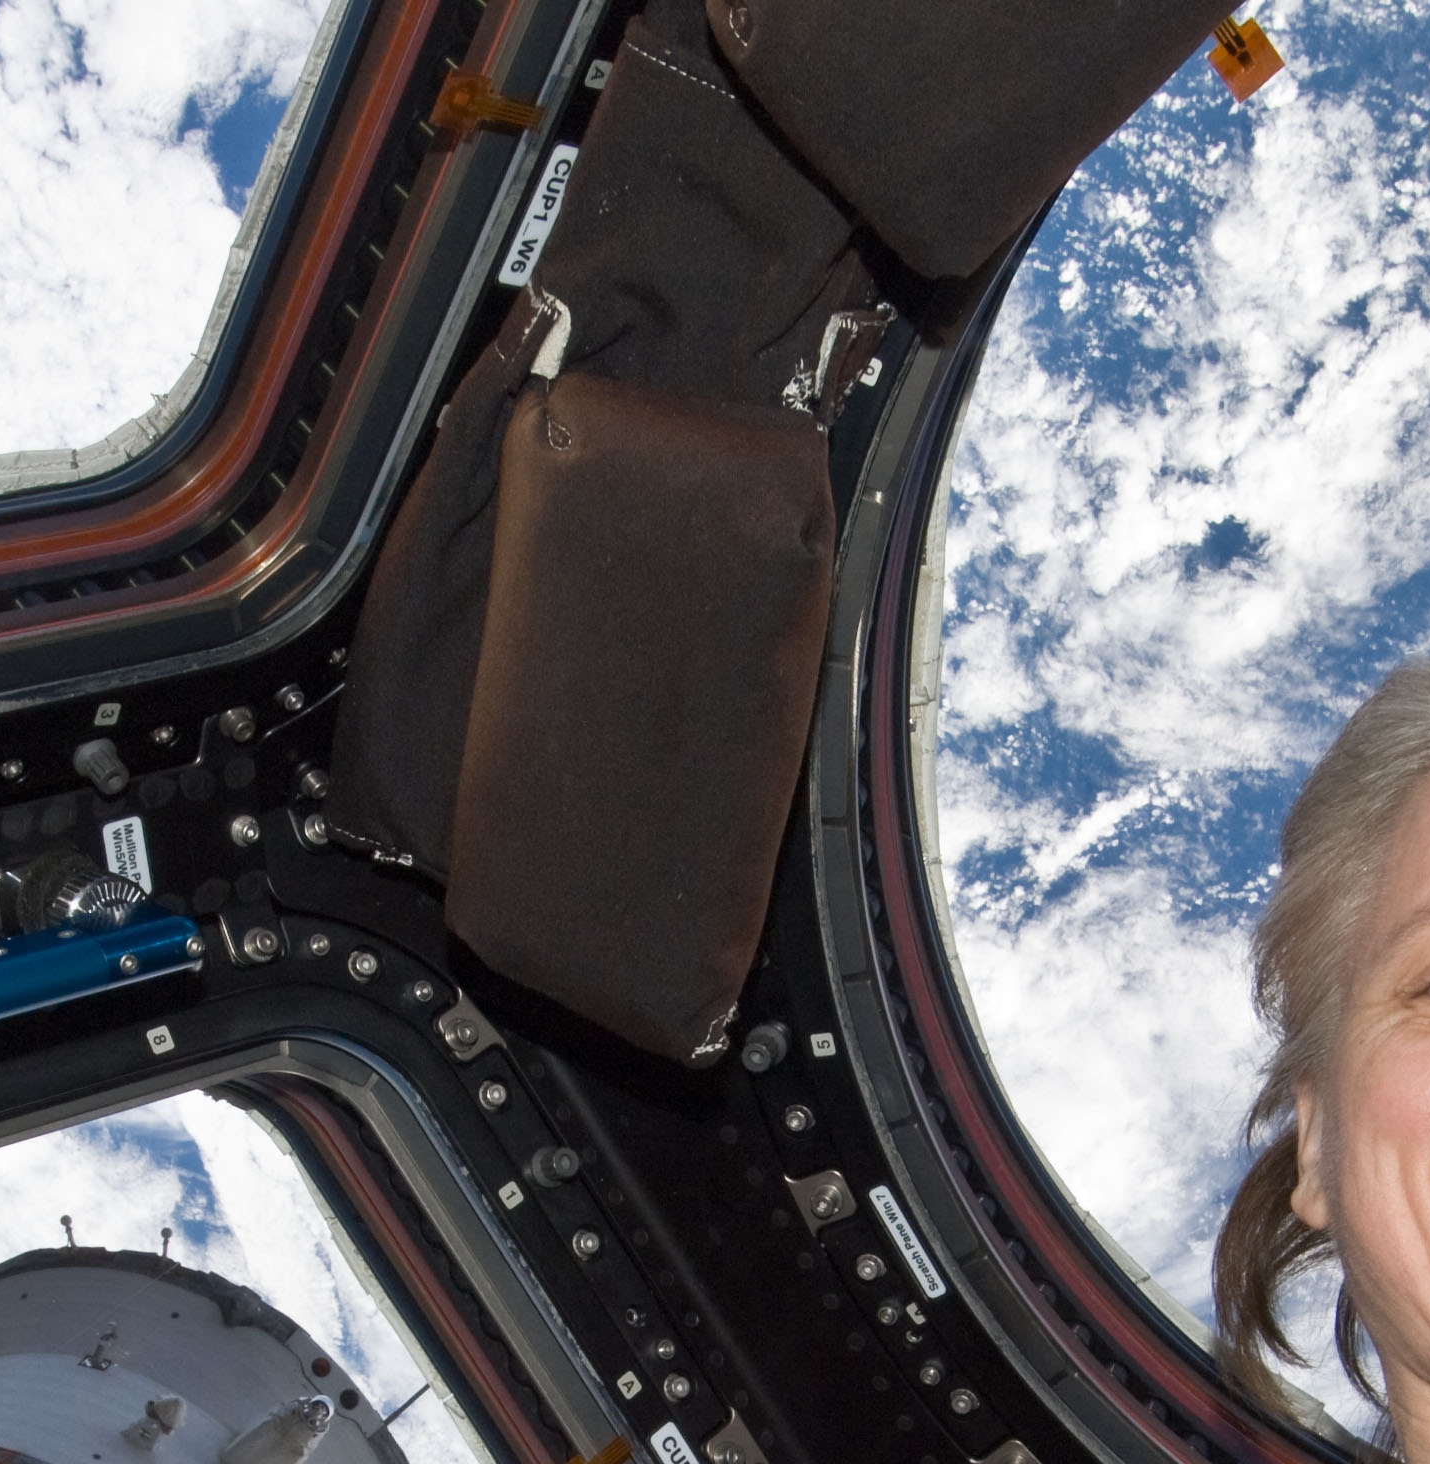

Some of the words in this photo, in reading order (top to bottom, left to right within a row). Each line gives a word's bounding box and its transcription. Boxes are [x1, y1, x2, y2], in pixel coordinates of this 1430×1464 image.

[590, 65, 605, 81] A
[510, 160, 572, 273] CUP1_W6
[101, 708, 115, 719] 3
[112, 829, 128, 877] Win5/W
[123, 824, 139, 870] Mullion
[153, 1033, 167, 1046] 8
[817, 1039, 831, 1050] 5
[505, 1189, 517, 1200] 1
[876, 1193, 886, 1202] 7
[880, 1200, 899, 1224] Win
[893, 1222, 916, 1251] Pane
[910, 1250, 940, 1292] Scratch
[621, 1380, 635, 1394] A
